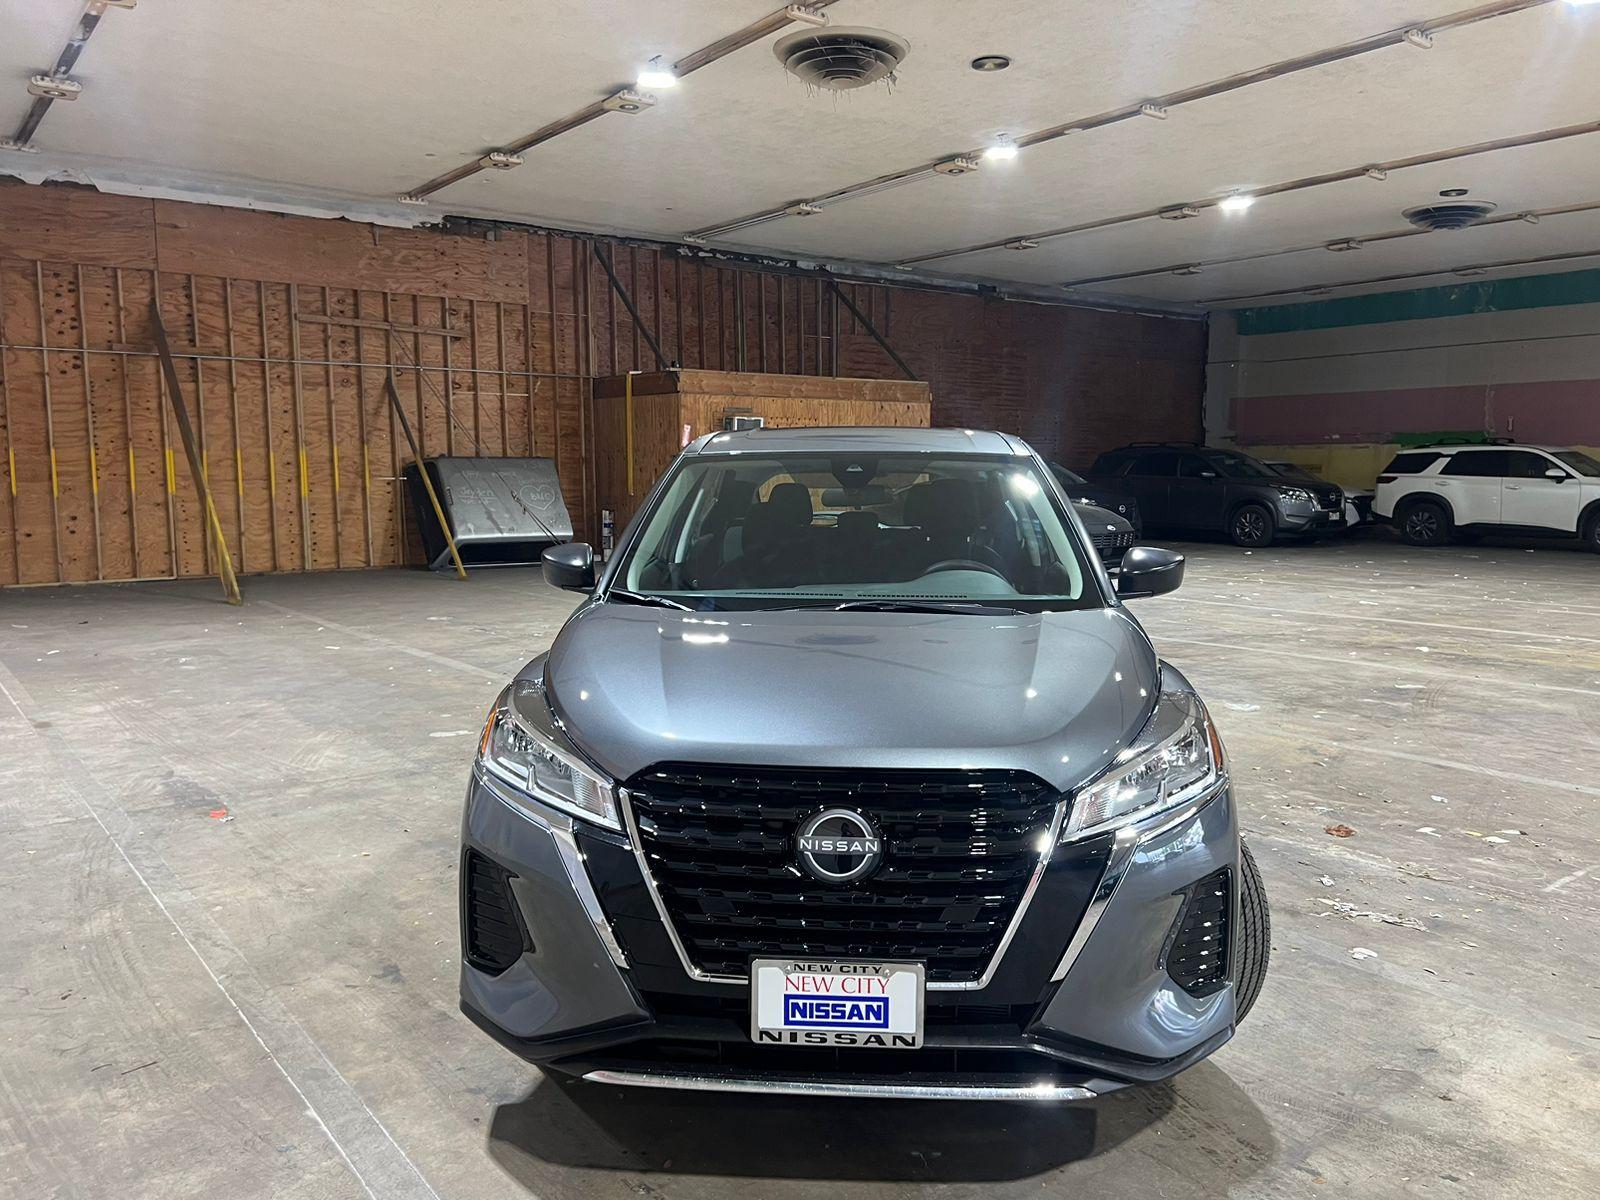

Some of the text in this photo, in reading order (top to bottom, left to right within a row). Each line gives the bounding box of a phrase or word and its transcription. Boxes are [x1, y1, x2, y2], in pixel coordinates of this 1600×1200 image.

[800, 838, 878, 852] NISSAN
[793, 963, 883, 974] NEW CITY
[785, 975, 891, 995] NEW CITY
[790, 1001, 883, 1021] NISSAN
[759, 1030, 916, 1047] NISSAN
